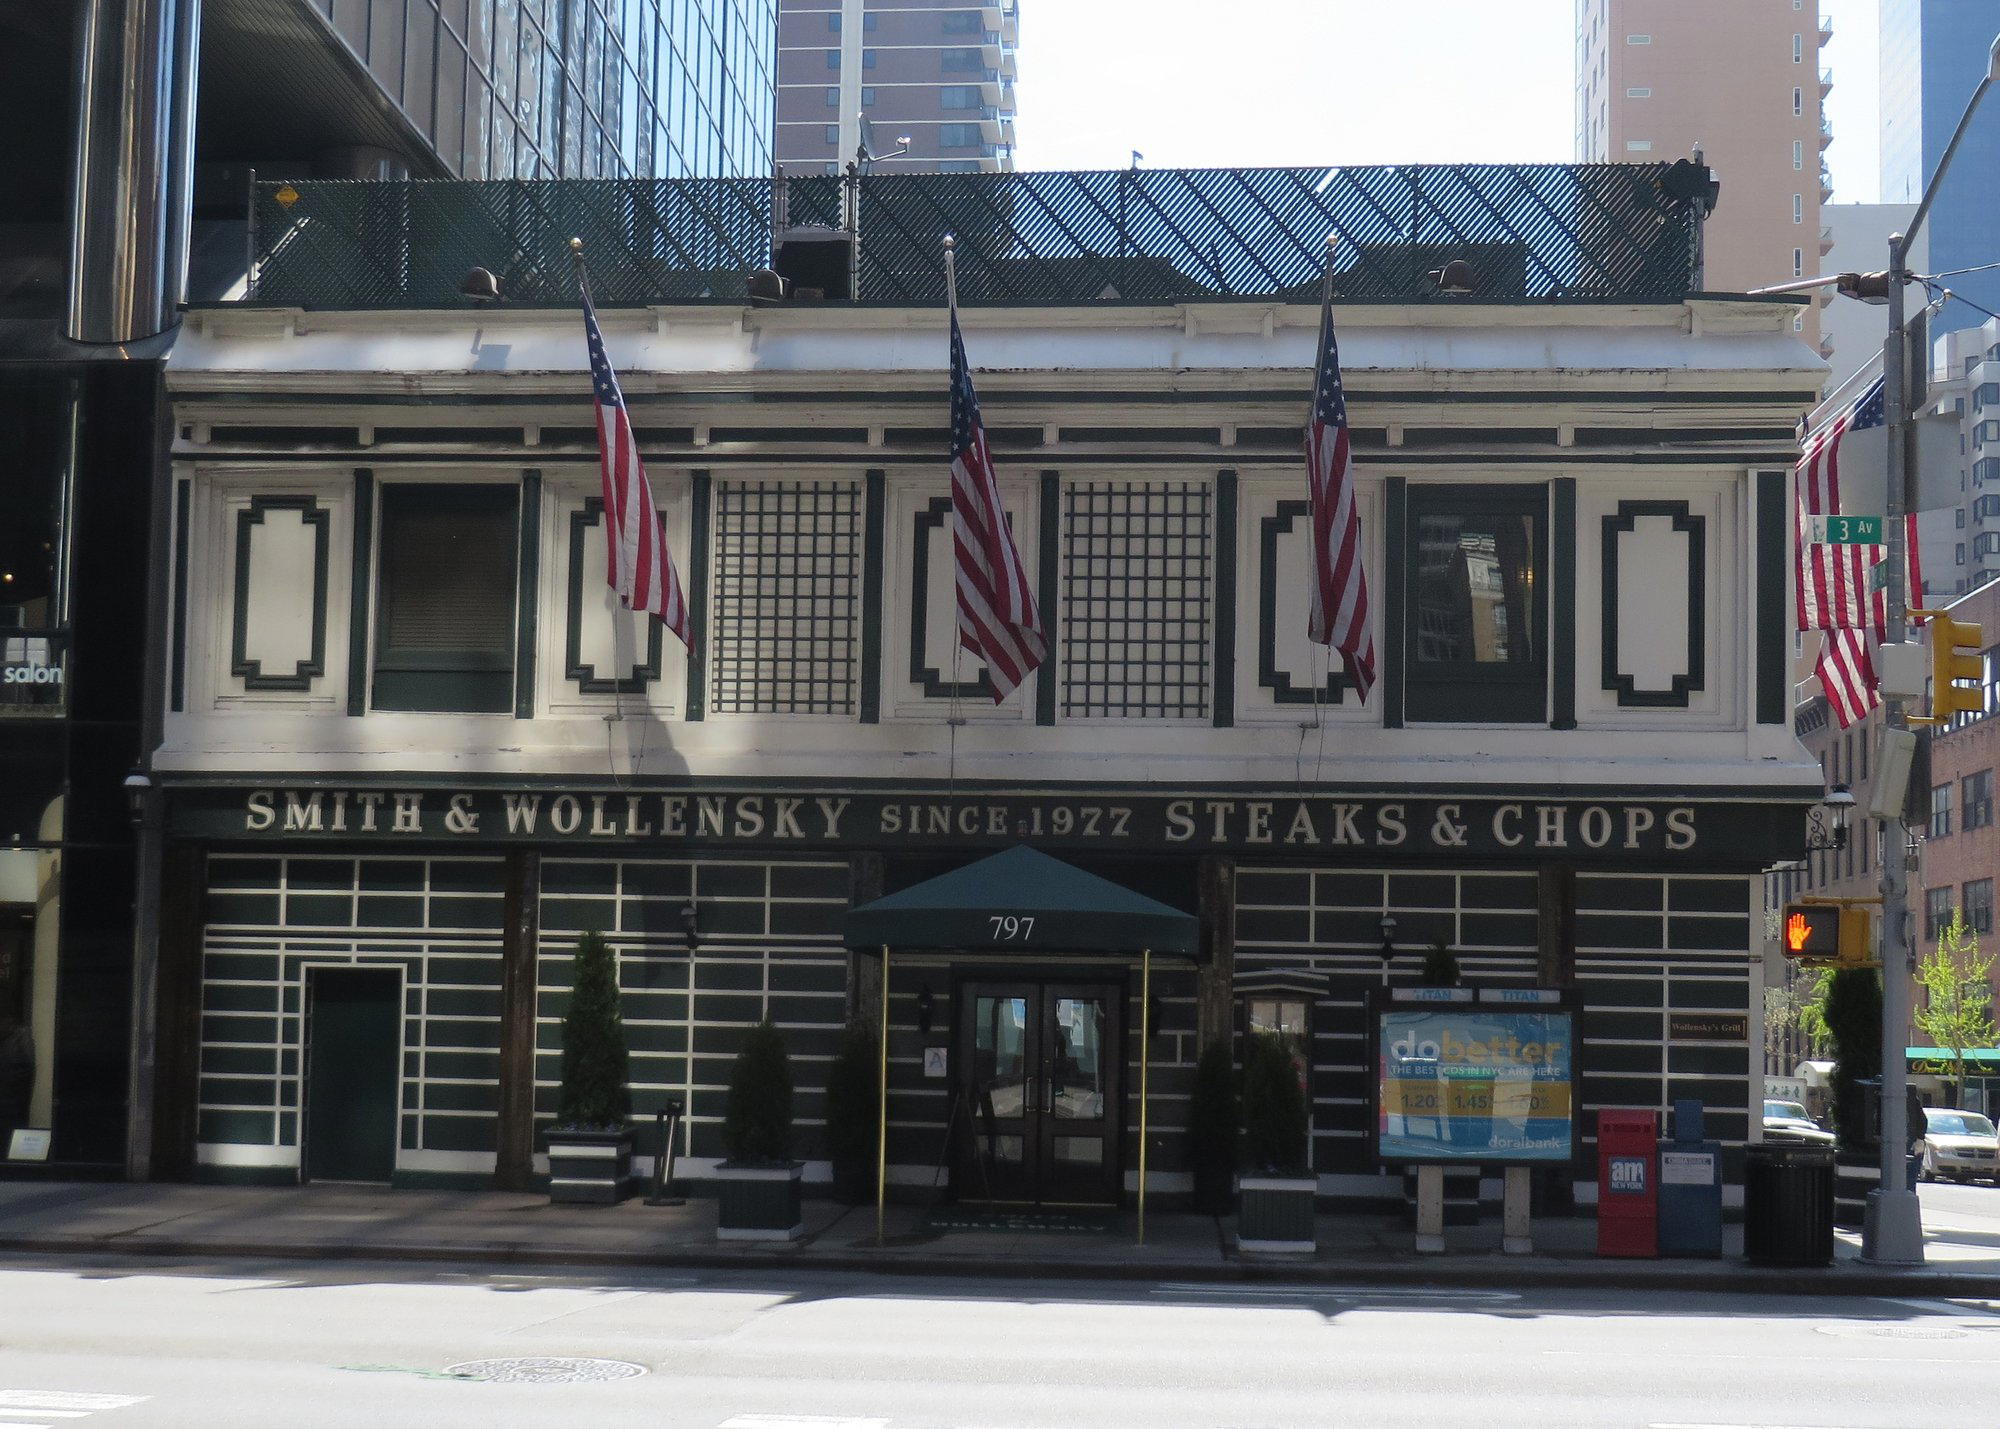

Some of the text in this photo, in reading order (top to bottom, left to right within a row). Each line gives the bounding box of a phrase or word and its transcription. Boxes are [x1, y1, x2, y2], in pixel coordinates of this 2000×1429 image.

[1839, 520, 1873, 541] 3 Av
[4, 660, 63, 684] salon
[246, 789, 1698, 850] SMITH & WOLLENSKY SINCE 1977 STEAKS & CHOPS
[988, 915, 1035, 941] 797
[1502, 991, 1540, 1002] TITAN
[1391, 1065, 1412, 1075] THE
[1415, 1065, 1441, 1075] BEST
[1467, 1066, 1480, 1075] IN
[1482, 1066, 1505, 1076] NYC
[1508, 1067, 1530, 1076] ARE
[1533, 1066, 1561, 1076] HERE
[1488, 1135, 1561, 1149] doralbank
[1611, 1161, 1644, 1184] am
[1611, 1181, 1644, 1190] NEW YORK
